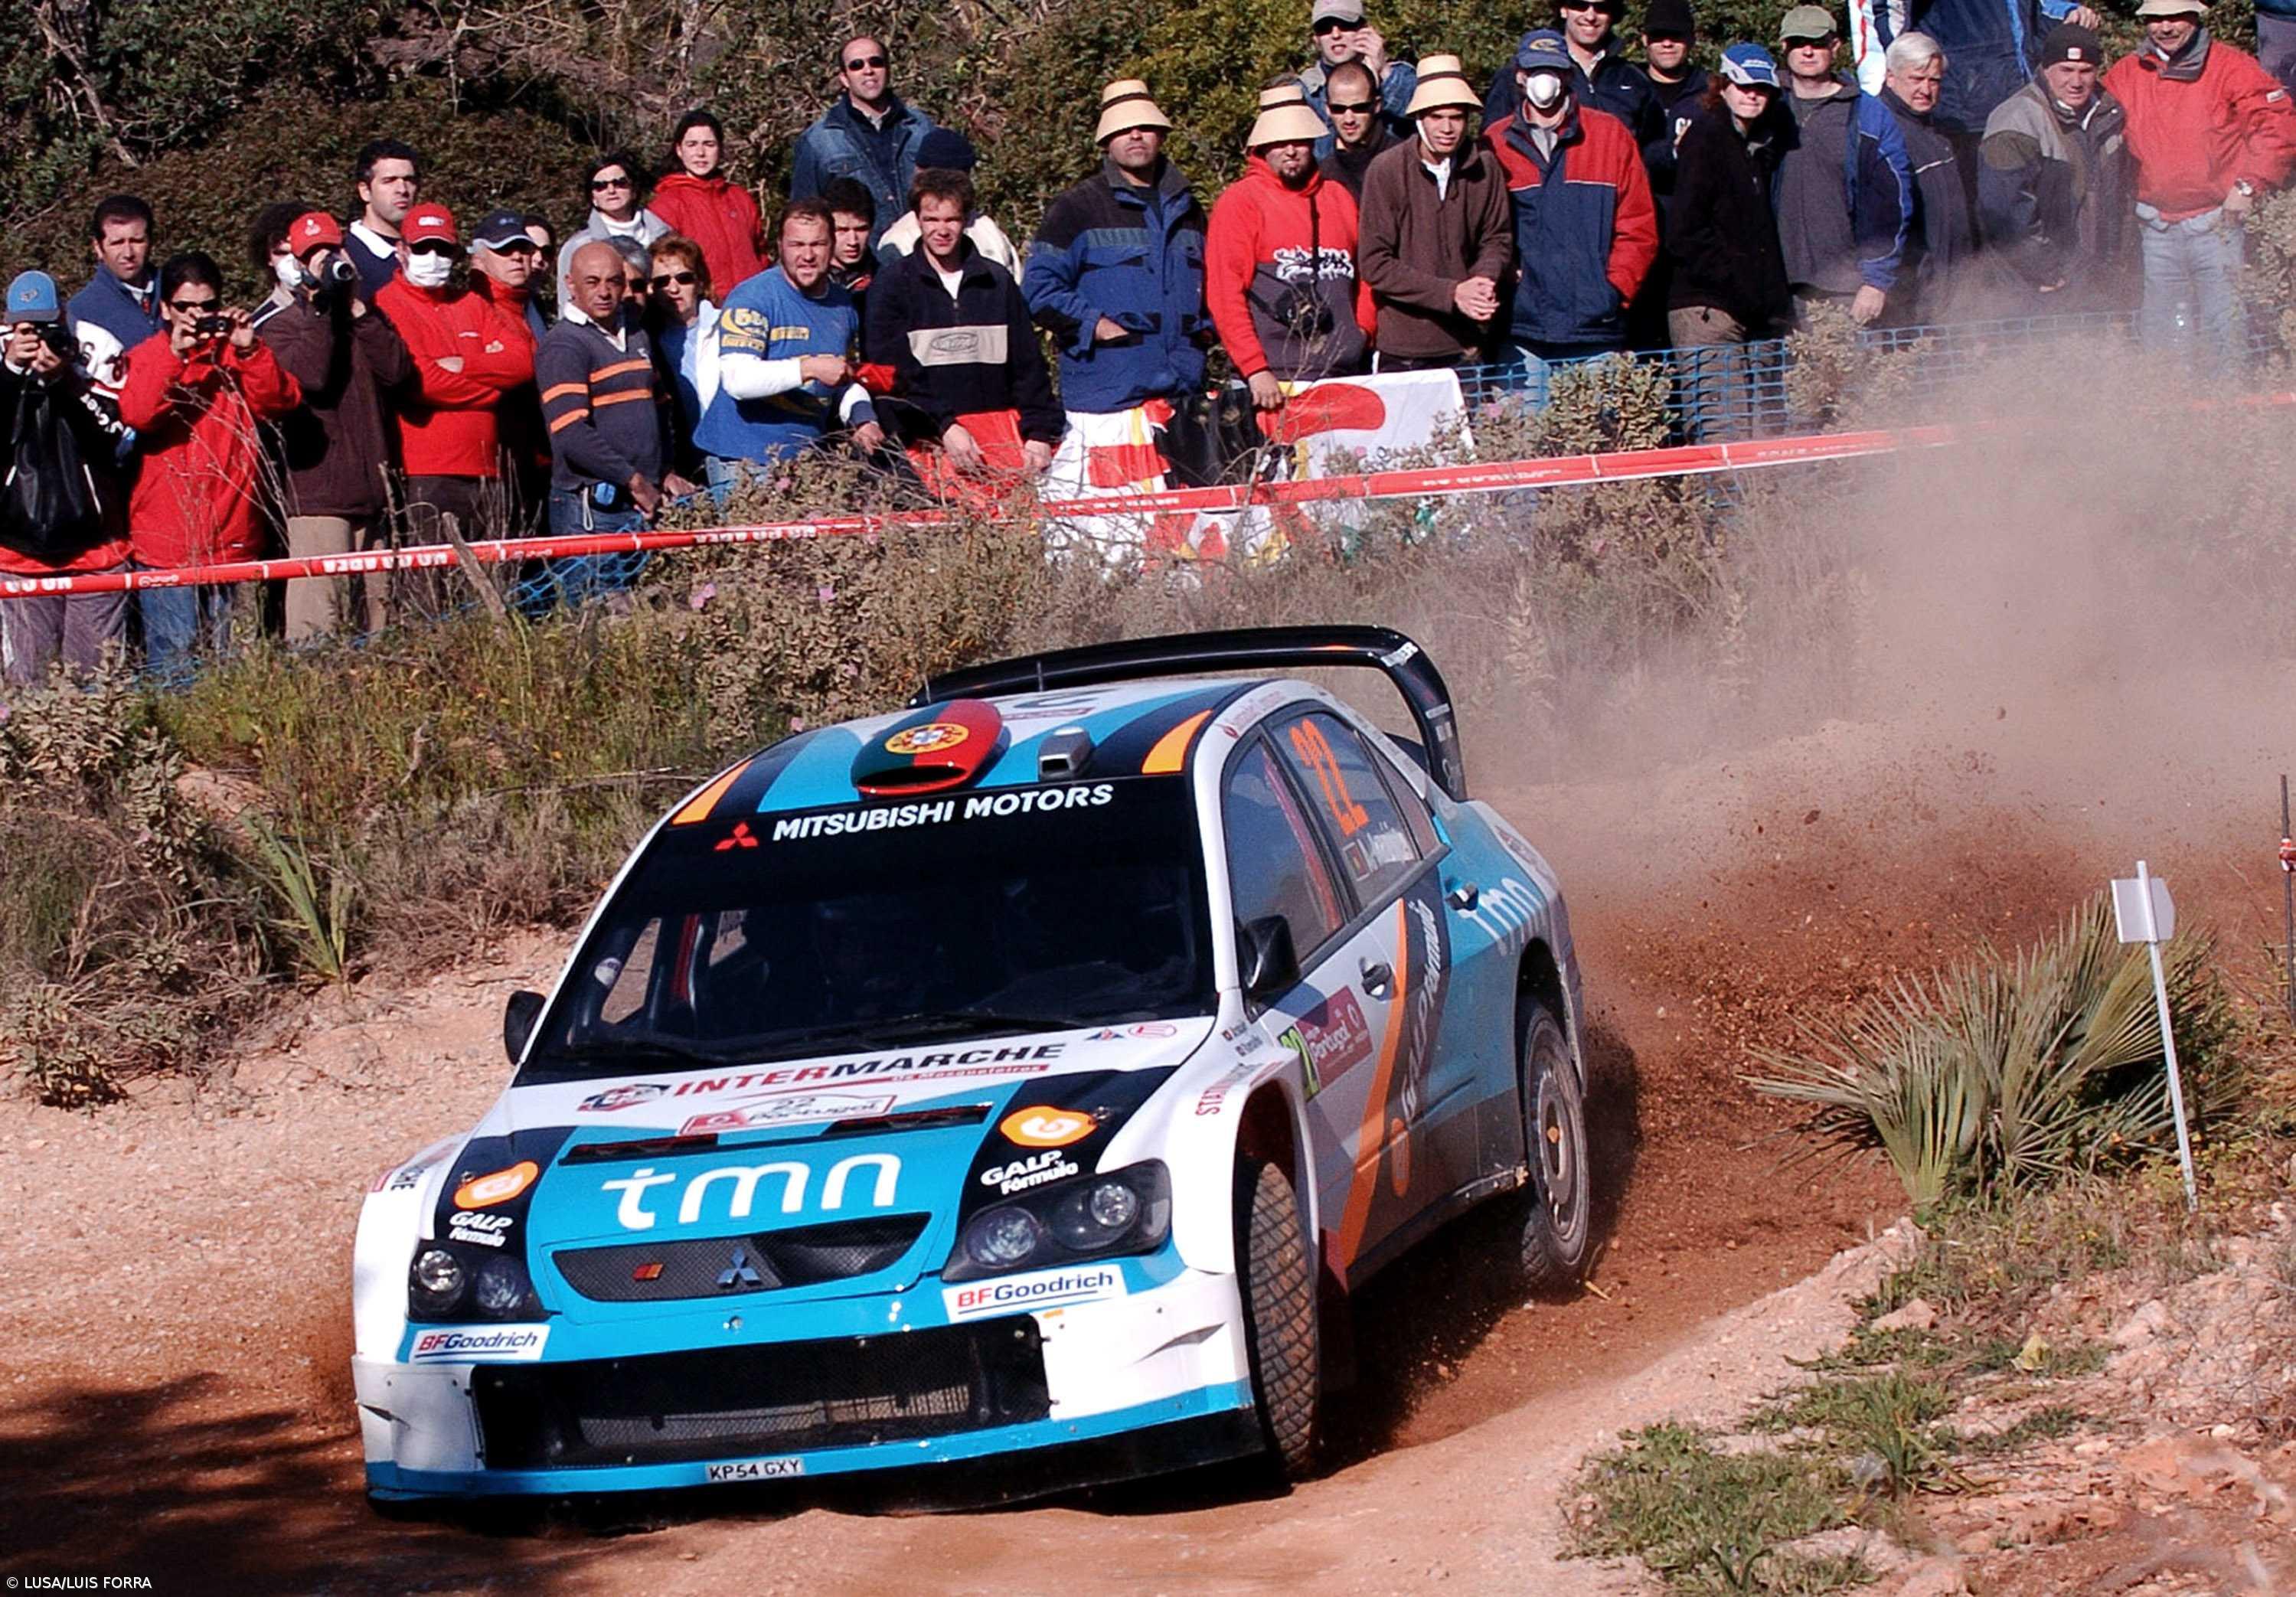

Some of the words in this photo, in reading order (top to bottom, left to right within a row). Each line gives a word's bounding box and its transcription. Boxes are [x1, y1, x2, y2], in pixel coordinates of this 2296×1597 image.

[1288, 717, 1370, 837] 22
[772, 801, 955, 841] MITSUBISHI
[963, 784, 1115, 819] MOTORS
[674, 1043, 1067, 1096] INTERMARCHE
[980, 1150, 1063, 1186] GALP
[601, 1153, 902, 1230] tmn
[449, 1211, 514, 1231] GALP
[958, 1272, 1113, 1308] BFGoodrich
[418, 1331, 538, 1351] BFGoodrich
[709, 1464, 759, 1481] KP54
[764, 1458, 800, 1475] GXY
